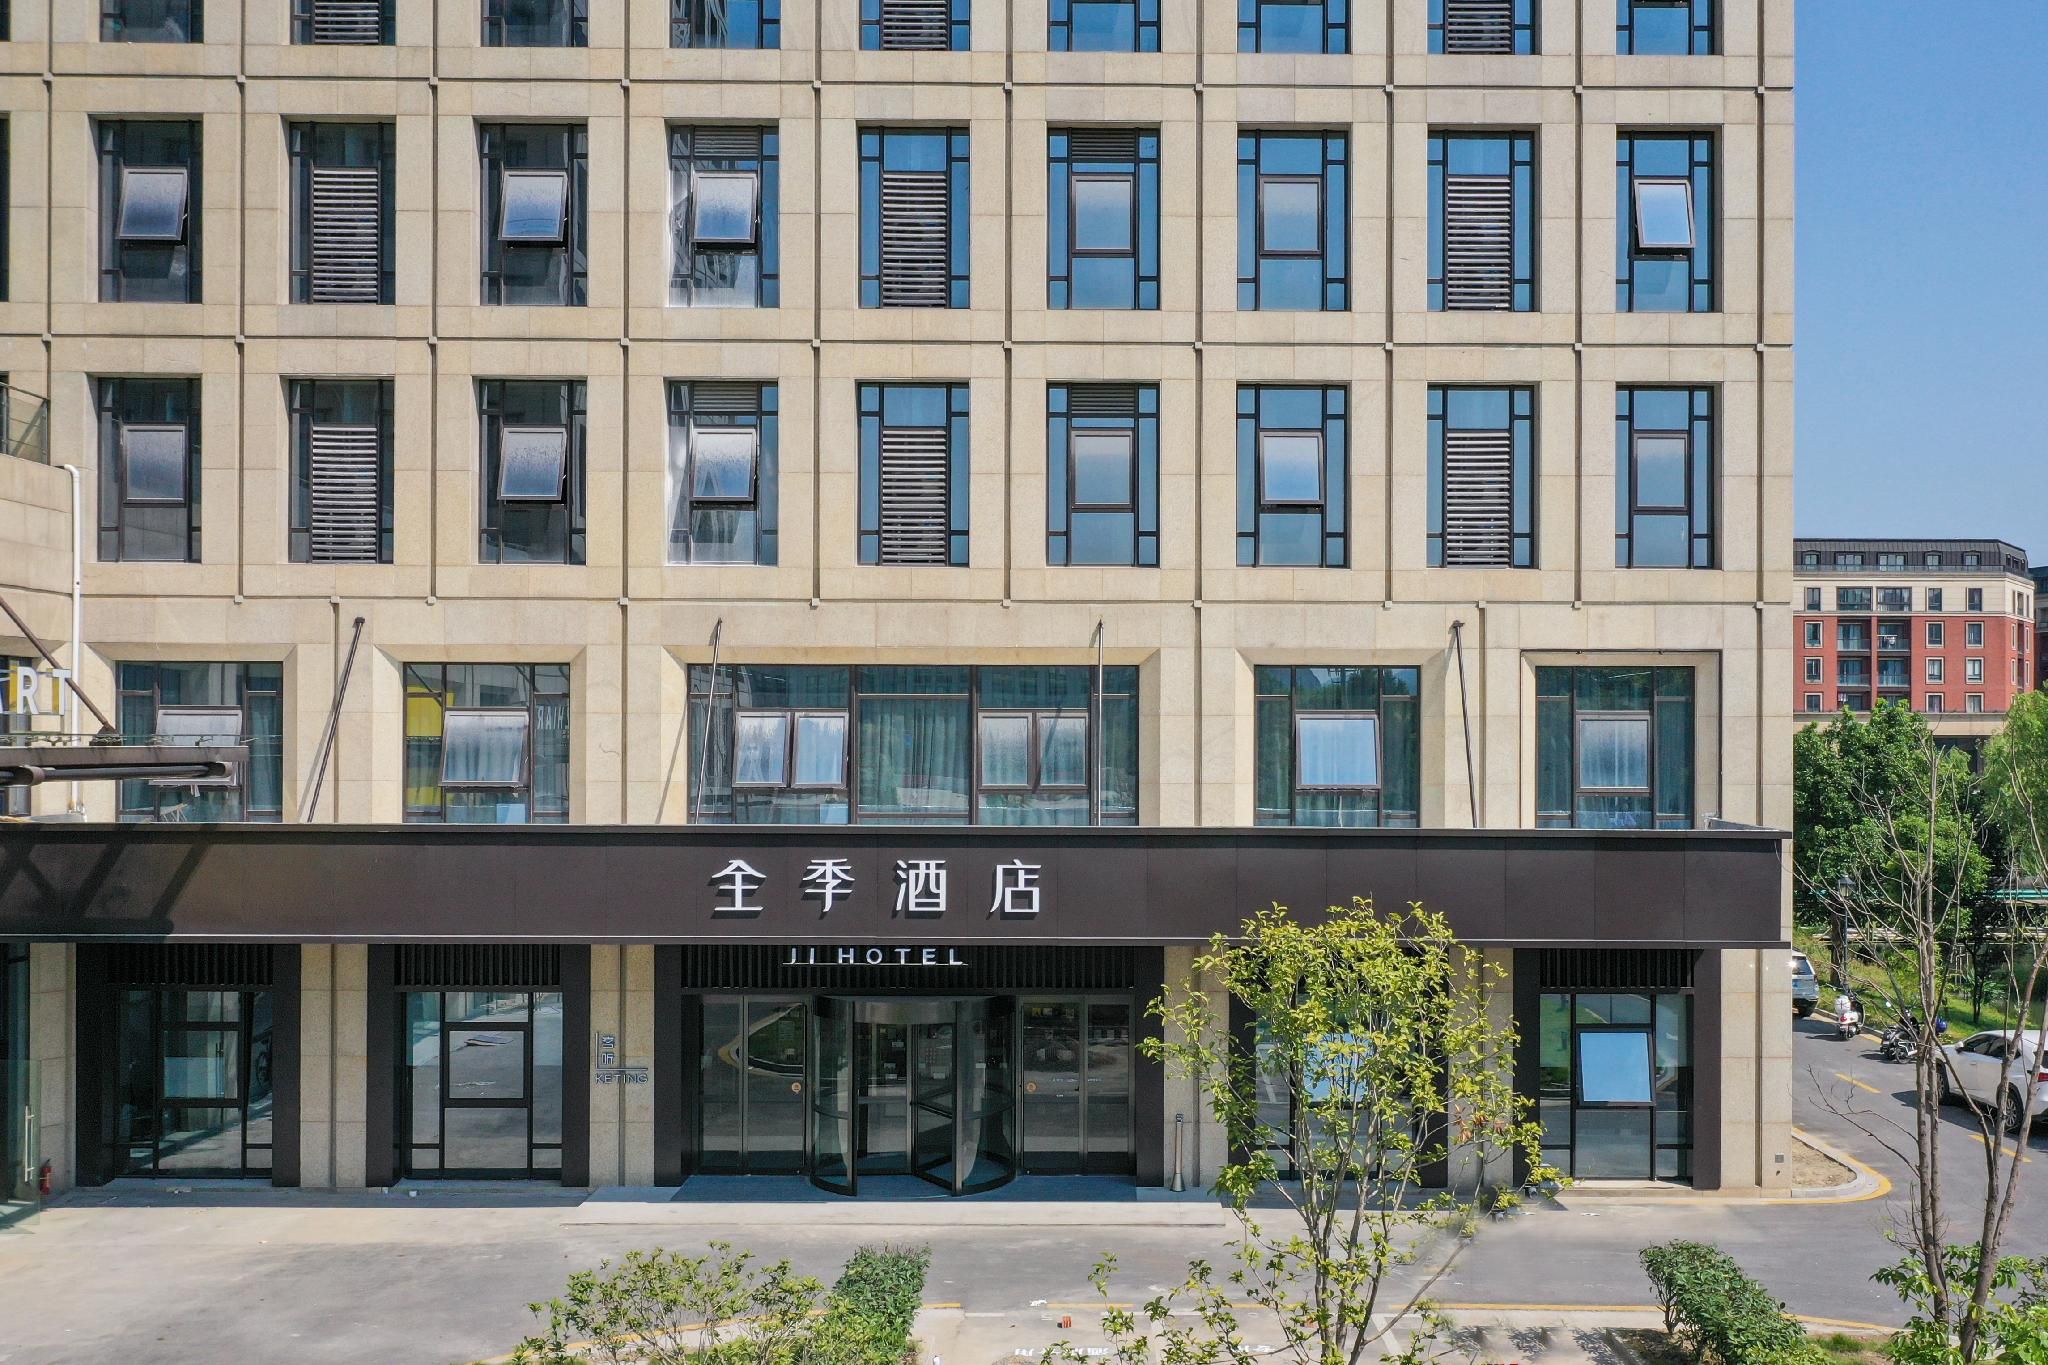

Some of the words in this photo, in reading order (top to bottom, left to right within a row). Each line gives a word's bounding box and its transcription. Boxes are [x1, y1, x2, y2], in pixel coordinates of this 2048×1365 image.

[0, 666, 71, 715] RT
[711, 858, 1042, 914] 全季酒店
[790, 947, 815, 966] JI
[838, 947, 964, 966] HOTEL
[595, 1073, 649, 1085] KETING
